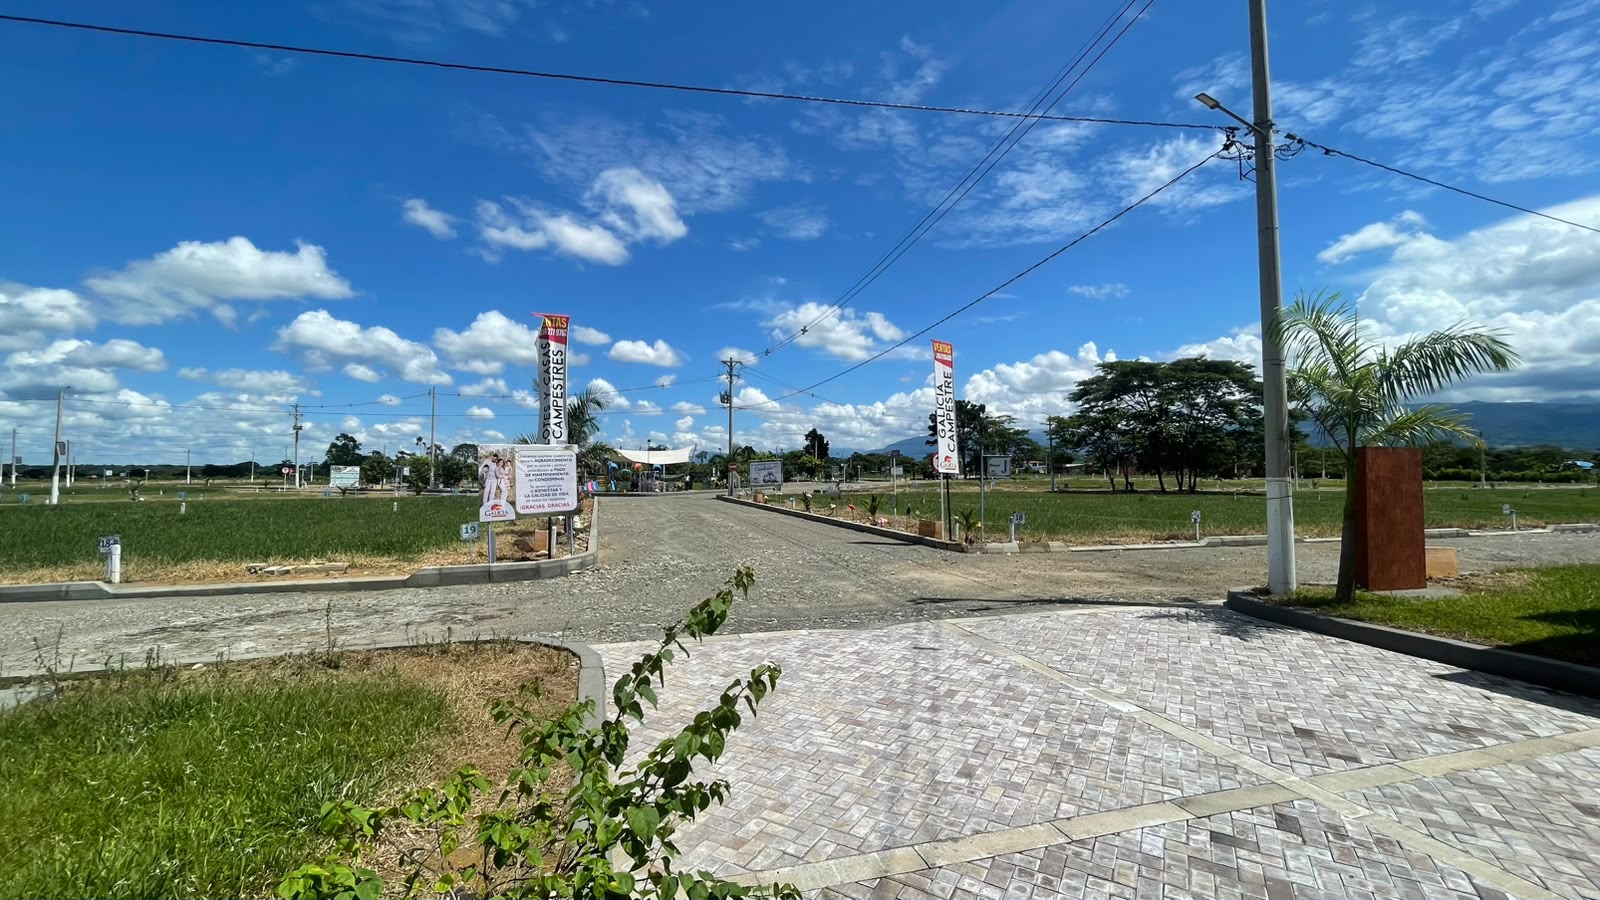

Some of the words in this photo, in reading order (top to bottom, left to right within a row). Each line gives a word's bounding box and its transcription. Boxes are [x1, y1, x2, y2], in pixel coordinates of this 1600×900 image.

[541, 342, 550, 386] CASAS
[544, 392, 550, 400] Y
[552, 350, 564, 439] CAMPESTRES
[936, 384, 946, 438] GALICIA
[944, 371, 956, 452] CAMPESTRE
[1001, 460, 1007, 473] J
[464, 526, 476, 534] 19
